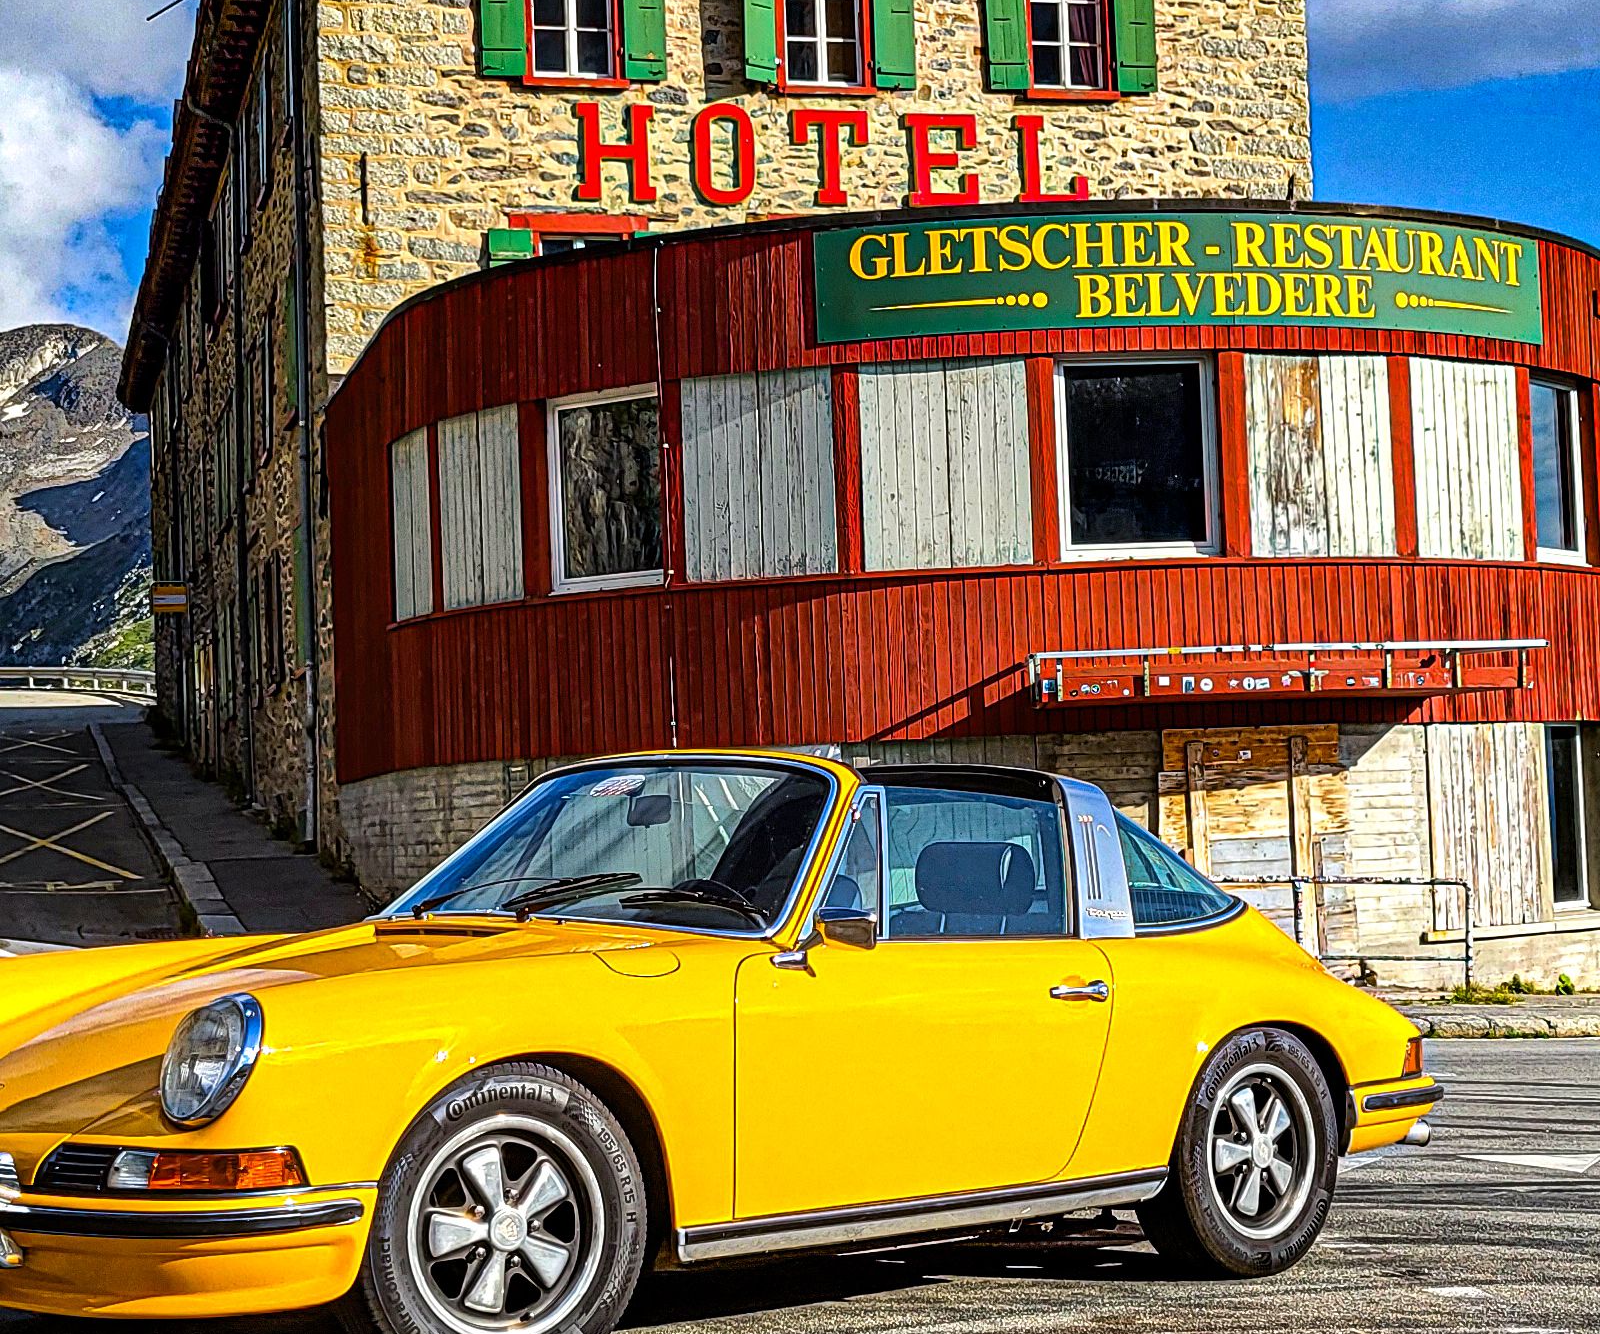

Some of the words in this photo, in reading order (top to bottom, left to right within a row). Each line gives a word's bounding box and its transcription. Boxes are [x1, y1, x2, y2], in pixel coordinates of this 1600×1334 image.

[575, 102, 1090, 207] HOTEL
[849, 221, 1195, 280] GLETSCHER
[1230, 221, 1522, 287] RESTAURANT
[1073, 272, 1376, 319] BELVEDERE
[1206, 1039, 1255, 1102] Continental
[1287, 1044, 1311, 1068] 195/65
[445, 1083, 543, 1122] Continental
[596, 1127, 627, 1173] 195/65
[626, 1211, 637, 1223] H
